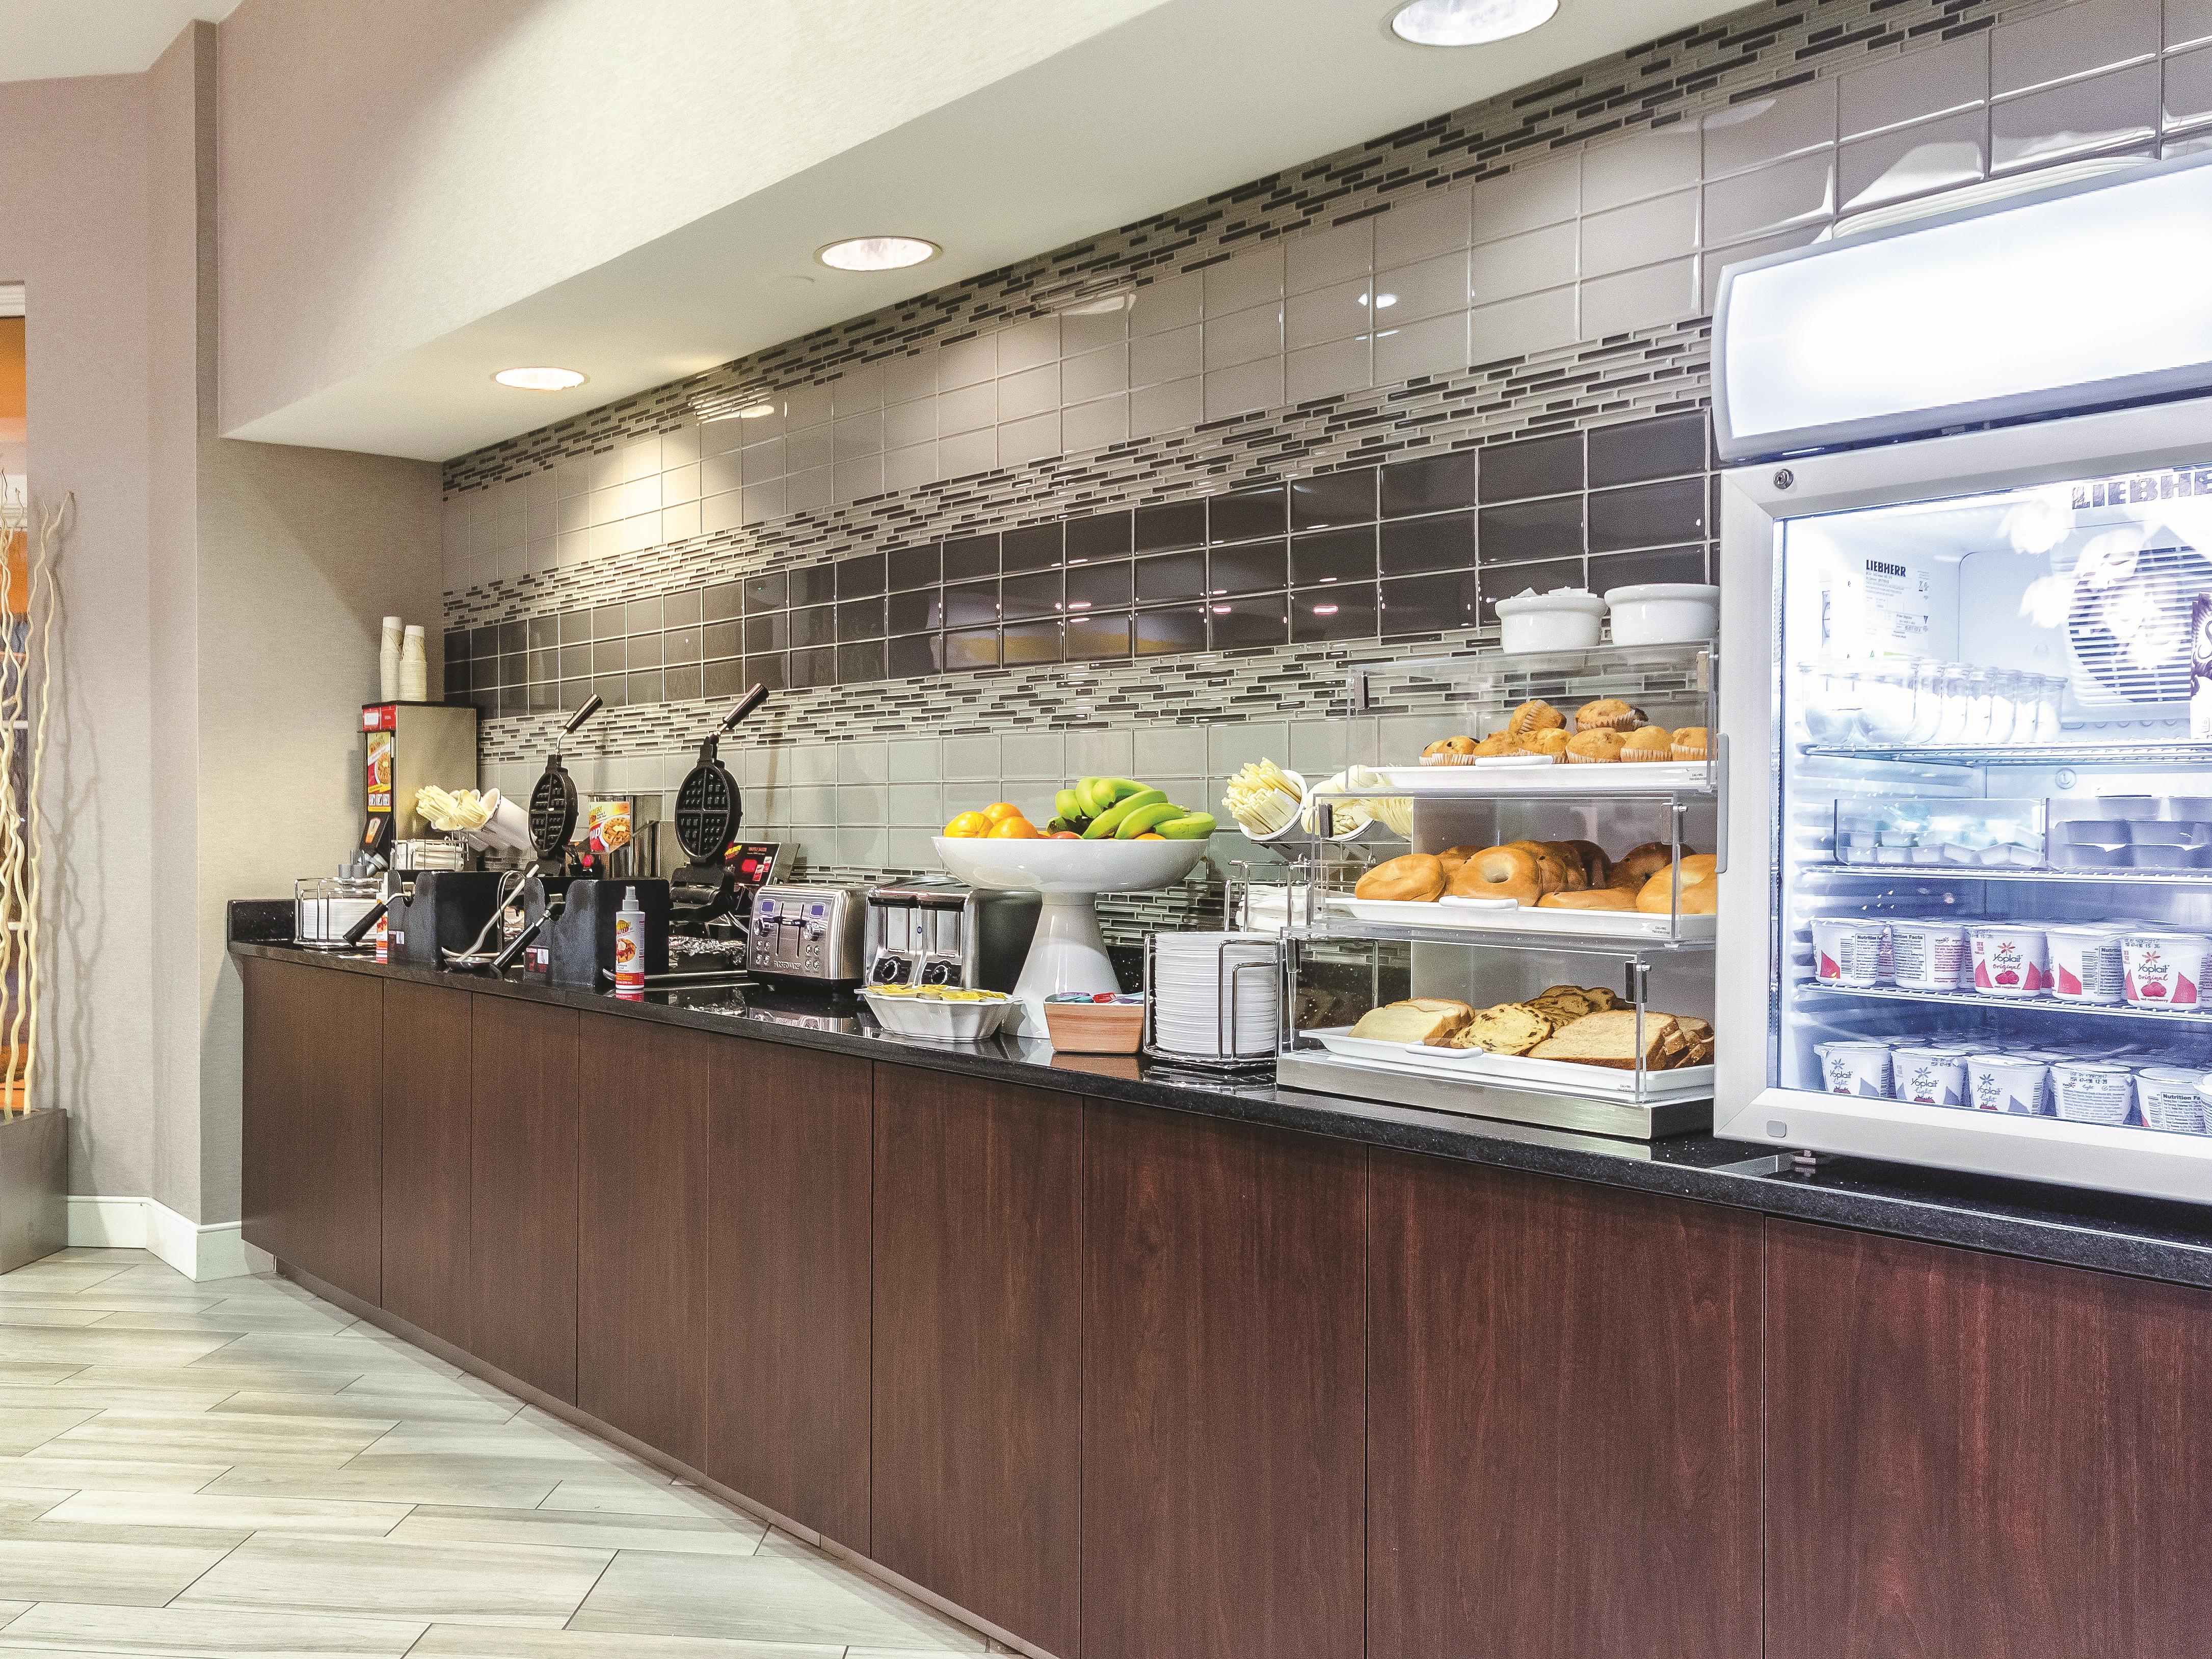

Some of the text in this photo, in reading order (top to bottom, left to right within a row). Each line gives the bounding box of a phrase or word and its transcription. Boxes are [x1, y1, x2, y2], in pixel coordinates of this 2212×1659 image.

[1866, 559, 1906, 577] LIEBHERR
[1993, 953, 2021, 964] Yoplait
[1993, 963, 2021, 973] Original
[2138, 963, 2168, 975] Yoplait
[2138, 974, 2168, 984] Original
[1830, 1069, 1851, 1080] Yoplait
[1911, 1078, 1937, 1089] Yoplait
[1977, 1084, 2001, 1096] Yoplait
